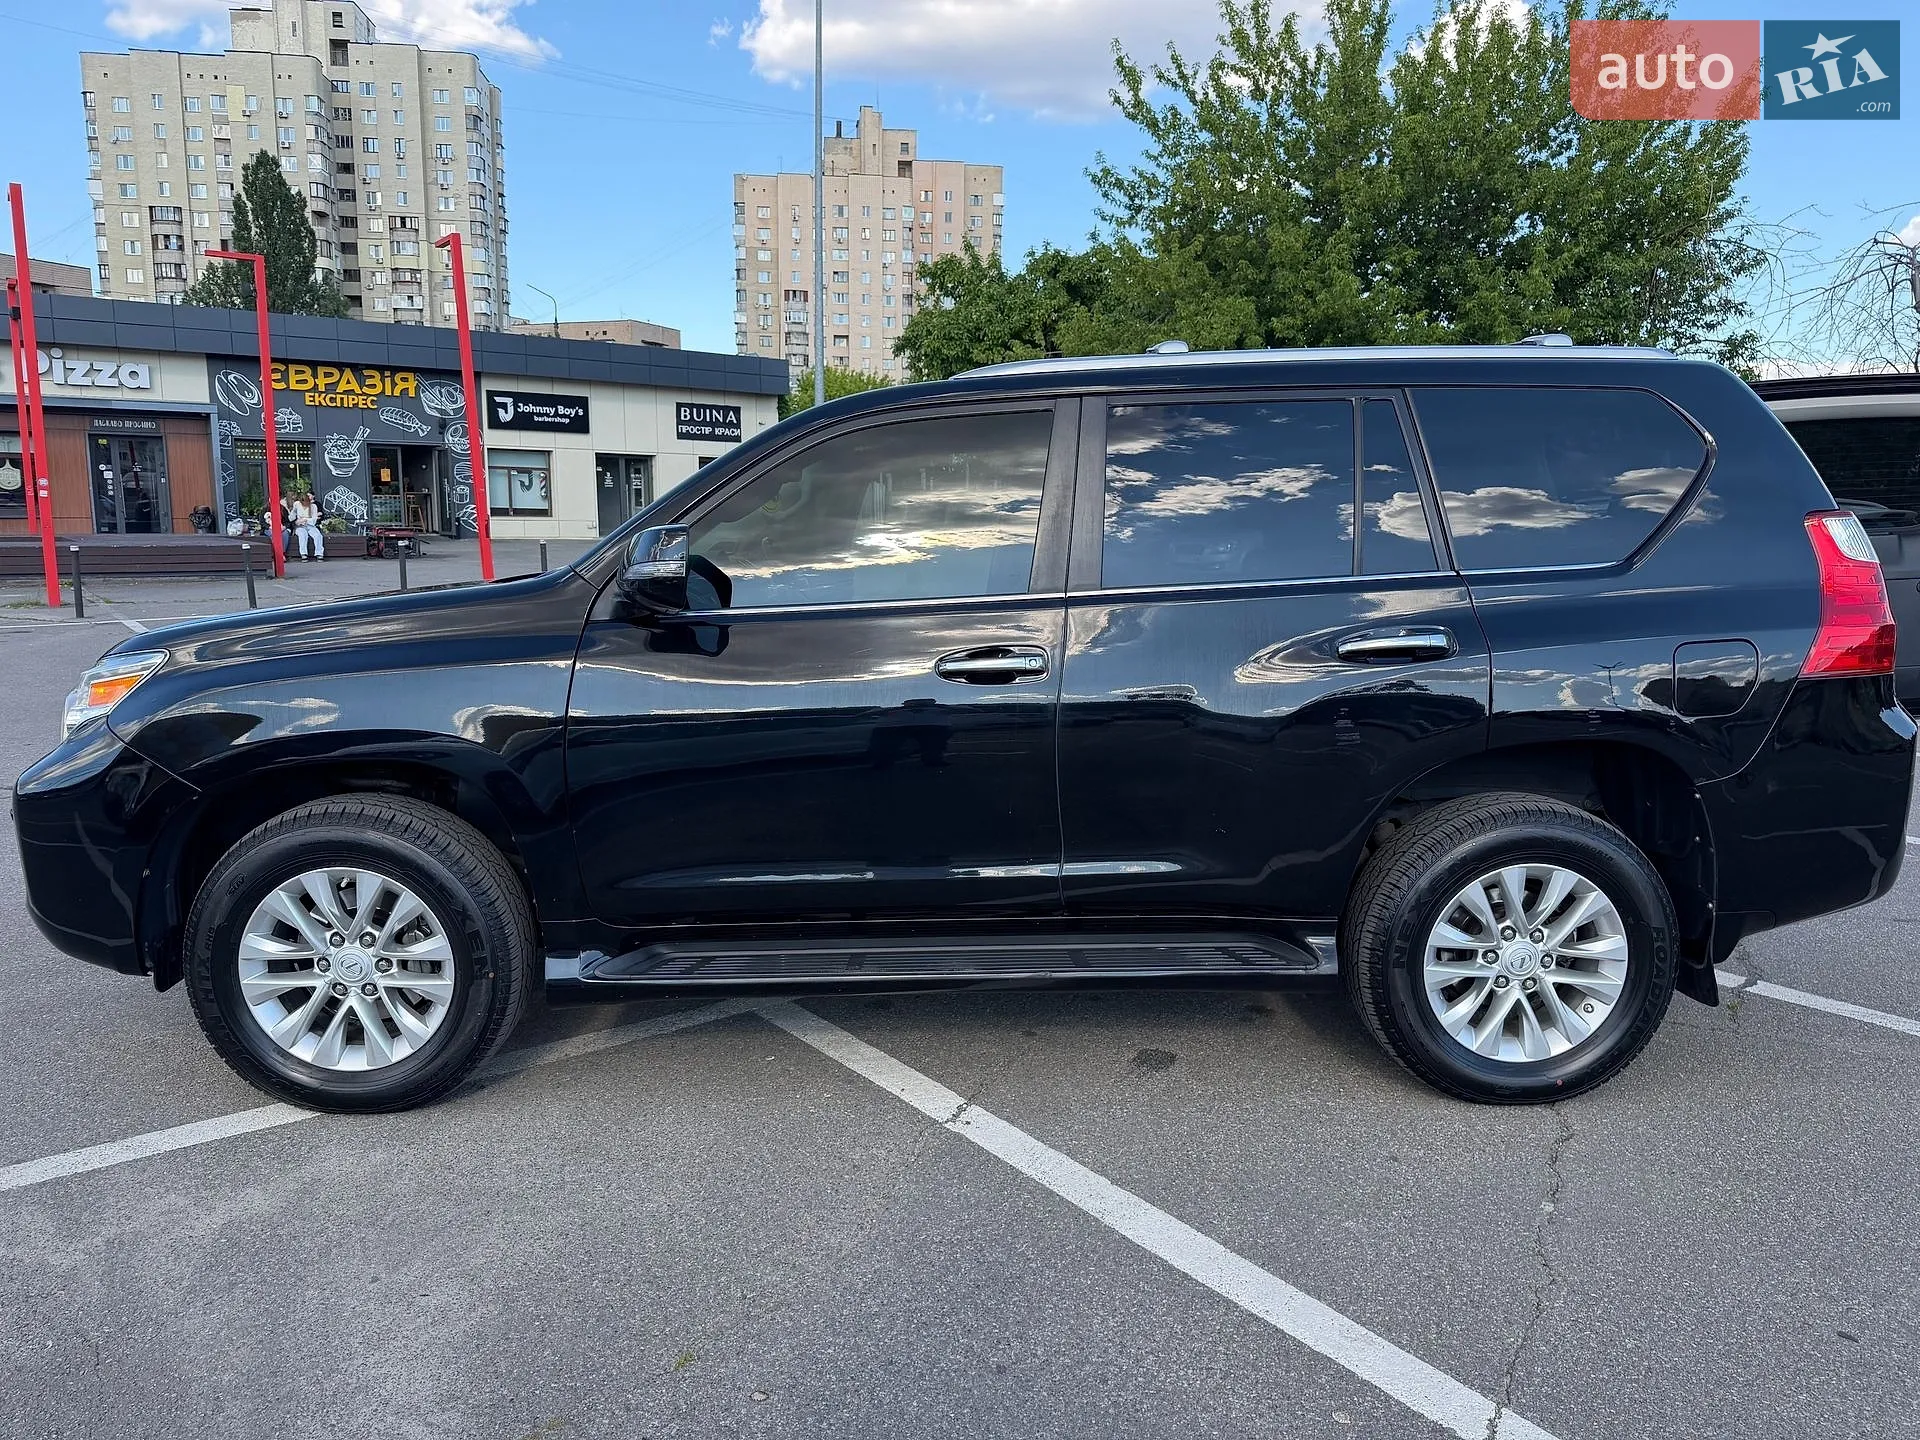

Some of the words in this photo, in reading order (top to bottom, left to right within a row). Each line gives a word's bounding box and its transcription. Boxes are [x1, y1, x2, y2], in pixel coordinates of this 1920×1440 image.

[304, 392, 378, 409] ЕКСПРЕС
[517, 403, 556, 416] Johnny
[557, 405, 584, 417] Boy's
[680, 407, 737, 424] BUINA
[533, 415, 570, 424] barbershop
[678, 425, 712, 435] ПРОСТІР
[714, 427, 741, 436] КРАСИ
